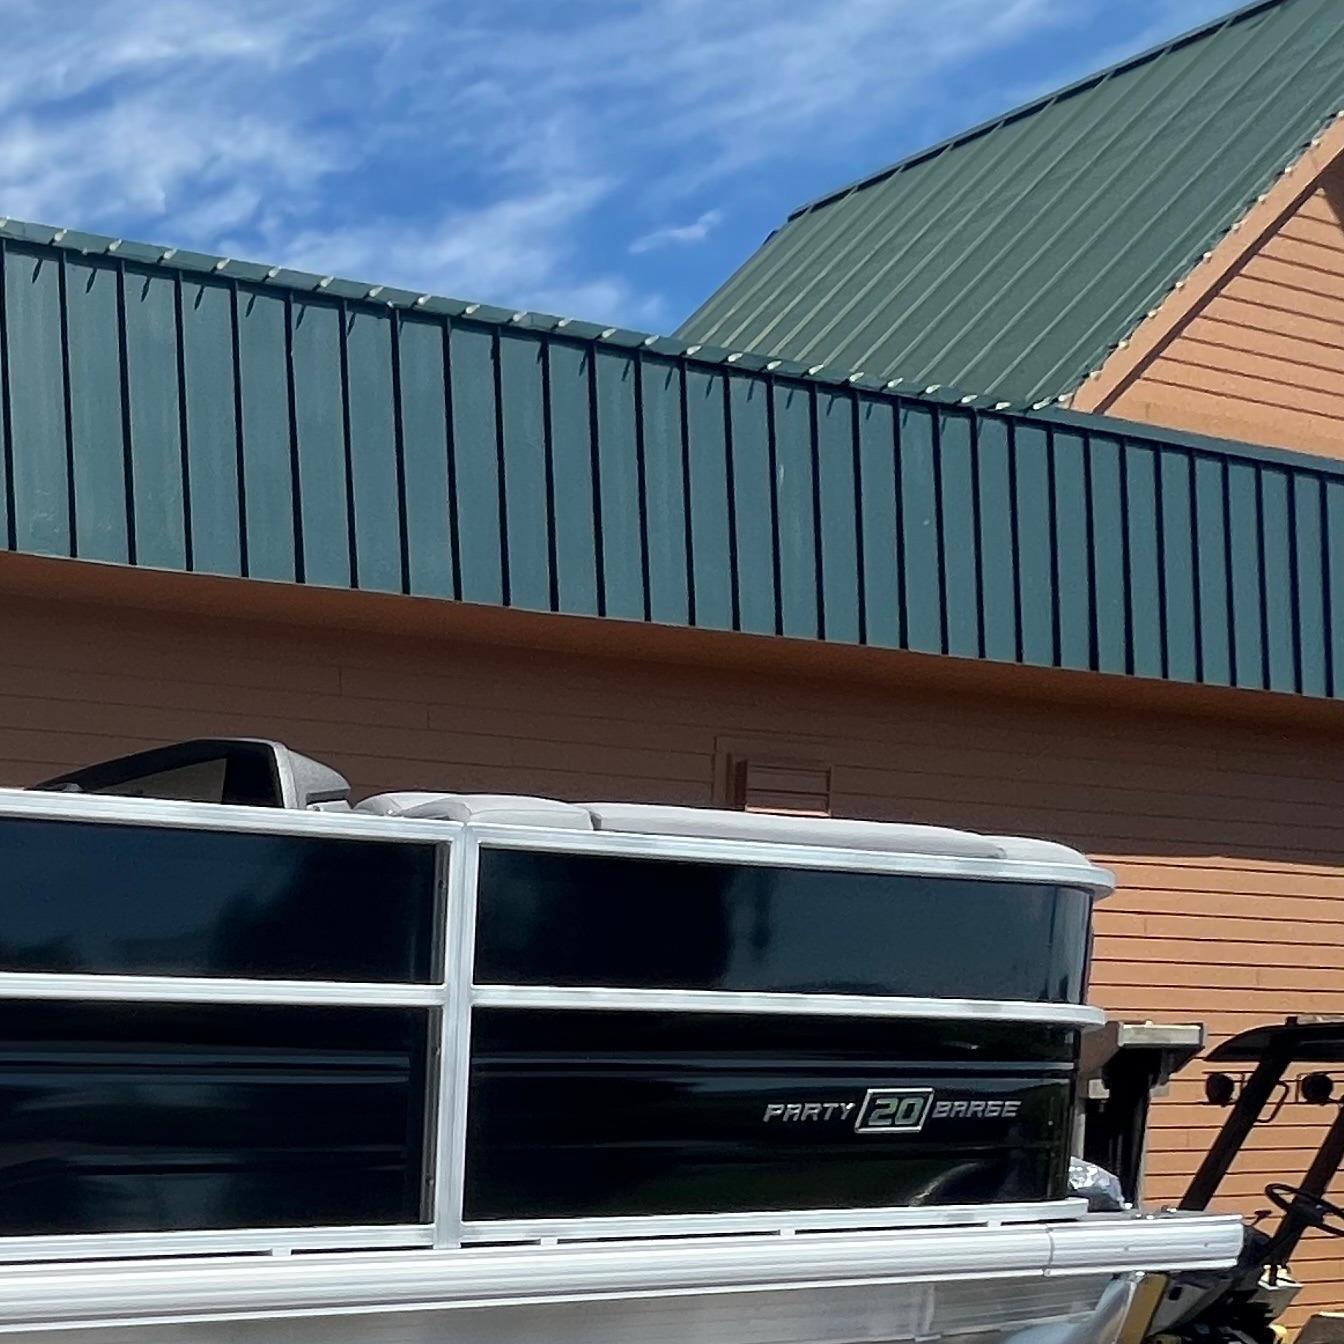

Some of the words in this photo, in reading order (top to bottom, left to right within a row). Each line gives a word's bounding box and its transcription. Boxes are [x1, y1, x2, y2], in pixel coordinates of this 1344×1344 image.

[762, 1102, 856, 1123] PARTY
[867, 1096, 925, 1126] 20
[931, 1099, 1023, 1119] BARGE
